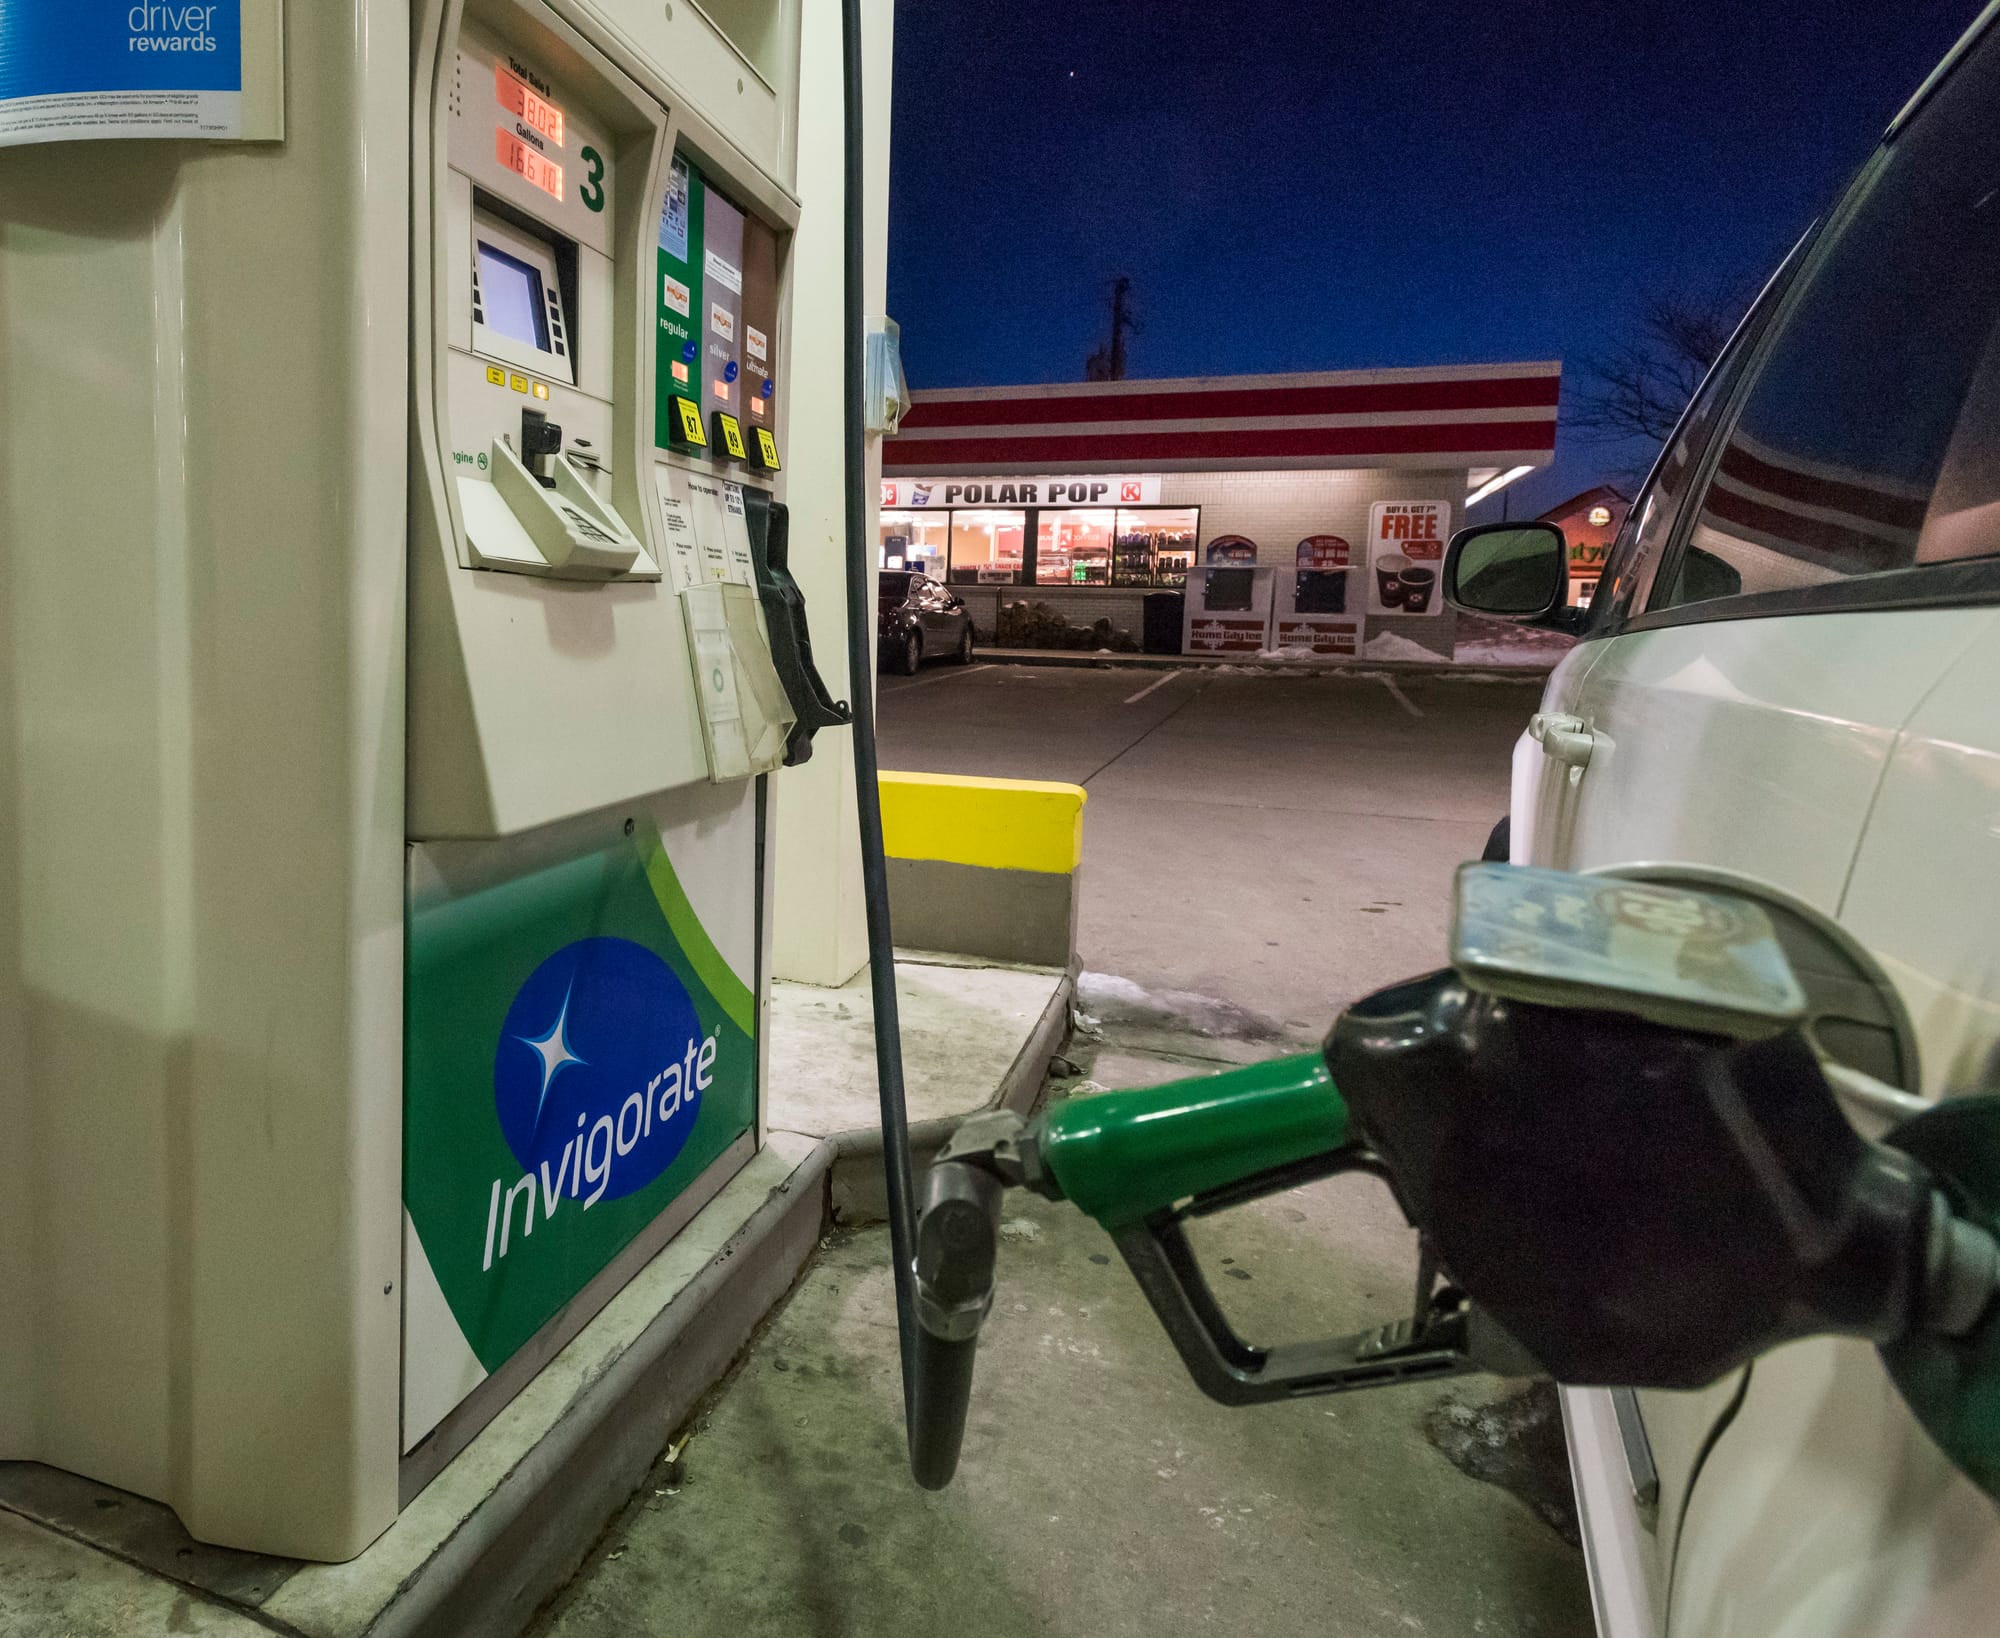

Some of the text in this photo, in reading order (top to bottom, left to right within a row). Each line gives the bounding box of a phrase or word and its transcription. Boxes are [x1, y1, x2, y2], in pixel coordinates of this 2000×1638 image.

[129, 0, 216, 32] driver
[129, 32, 217, 52] rewards
[510, 57, 527, 79] Total
[529, 72, 545, 92] Sale
[515, 122, 545, 150] Gallons
[579, 145, 605, 213] 3
[659, 317, 689, 340] regular
[709, 344, 730, 361] silver
[685, 415, 698, 436] 87
[945, 483, 1038, 504] POLAR
[1048, 482, 1108, 503] POP
[1386, 505, 1401, 513] BUY
[1381, 514, 1437, 540] FREE
[483, 1034, 718, 1273] Invigorate
